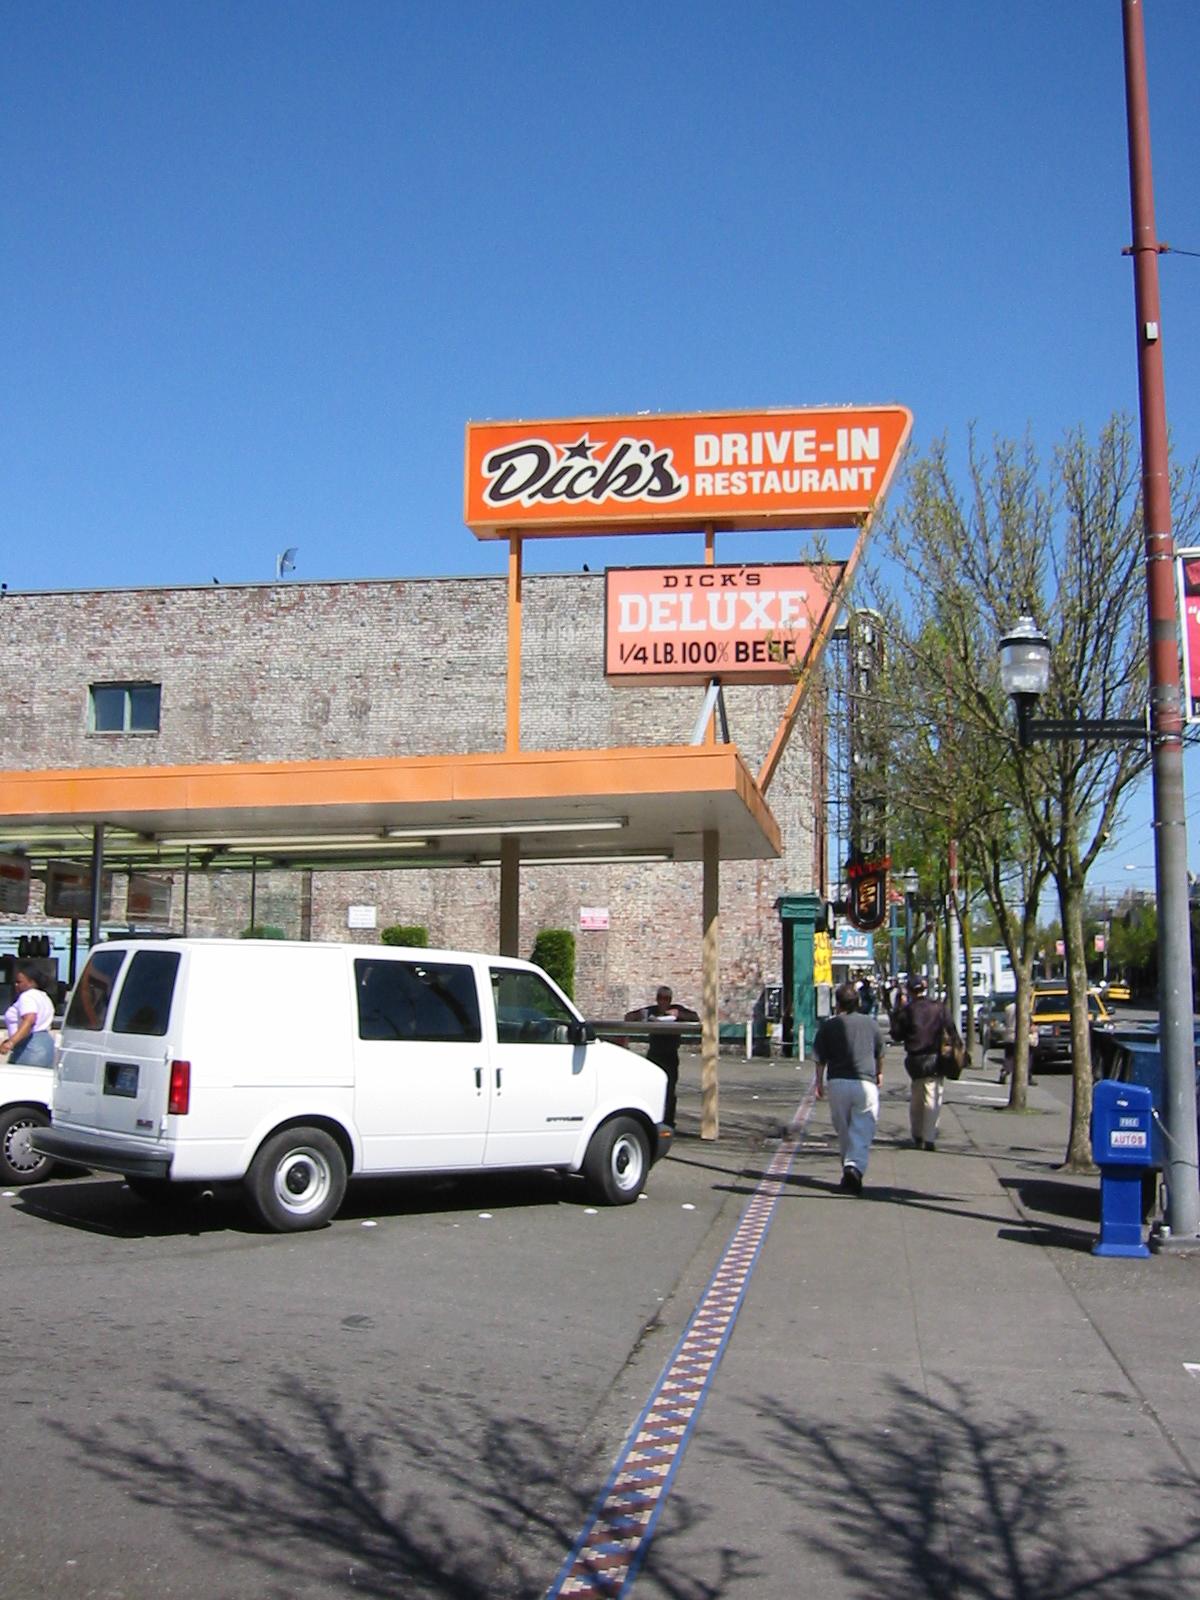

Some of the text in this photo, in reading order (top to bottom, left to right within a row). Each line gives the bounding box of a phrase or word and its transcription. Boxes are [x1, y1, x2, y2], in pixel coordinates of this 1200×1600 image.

[694, 427, 880, 467] DRIVE-IN
[484, 434, 687, 506] Dick's
[694, 466, 876, 497] RESTAURANT
[663, 570, 761, 588] DICK'S
[618, 590, 807, 633] DELUXE
[619, 642, 648, 664] 1/4
[735, 640, 796, 663] BEEF
